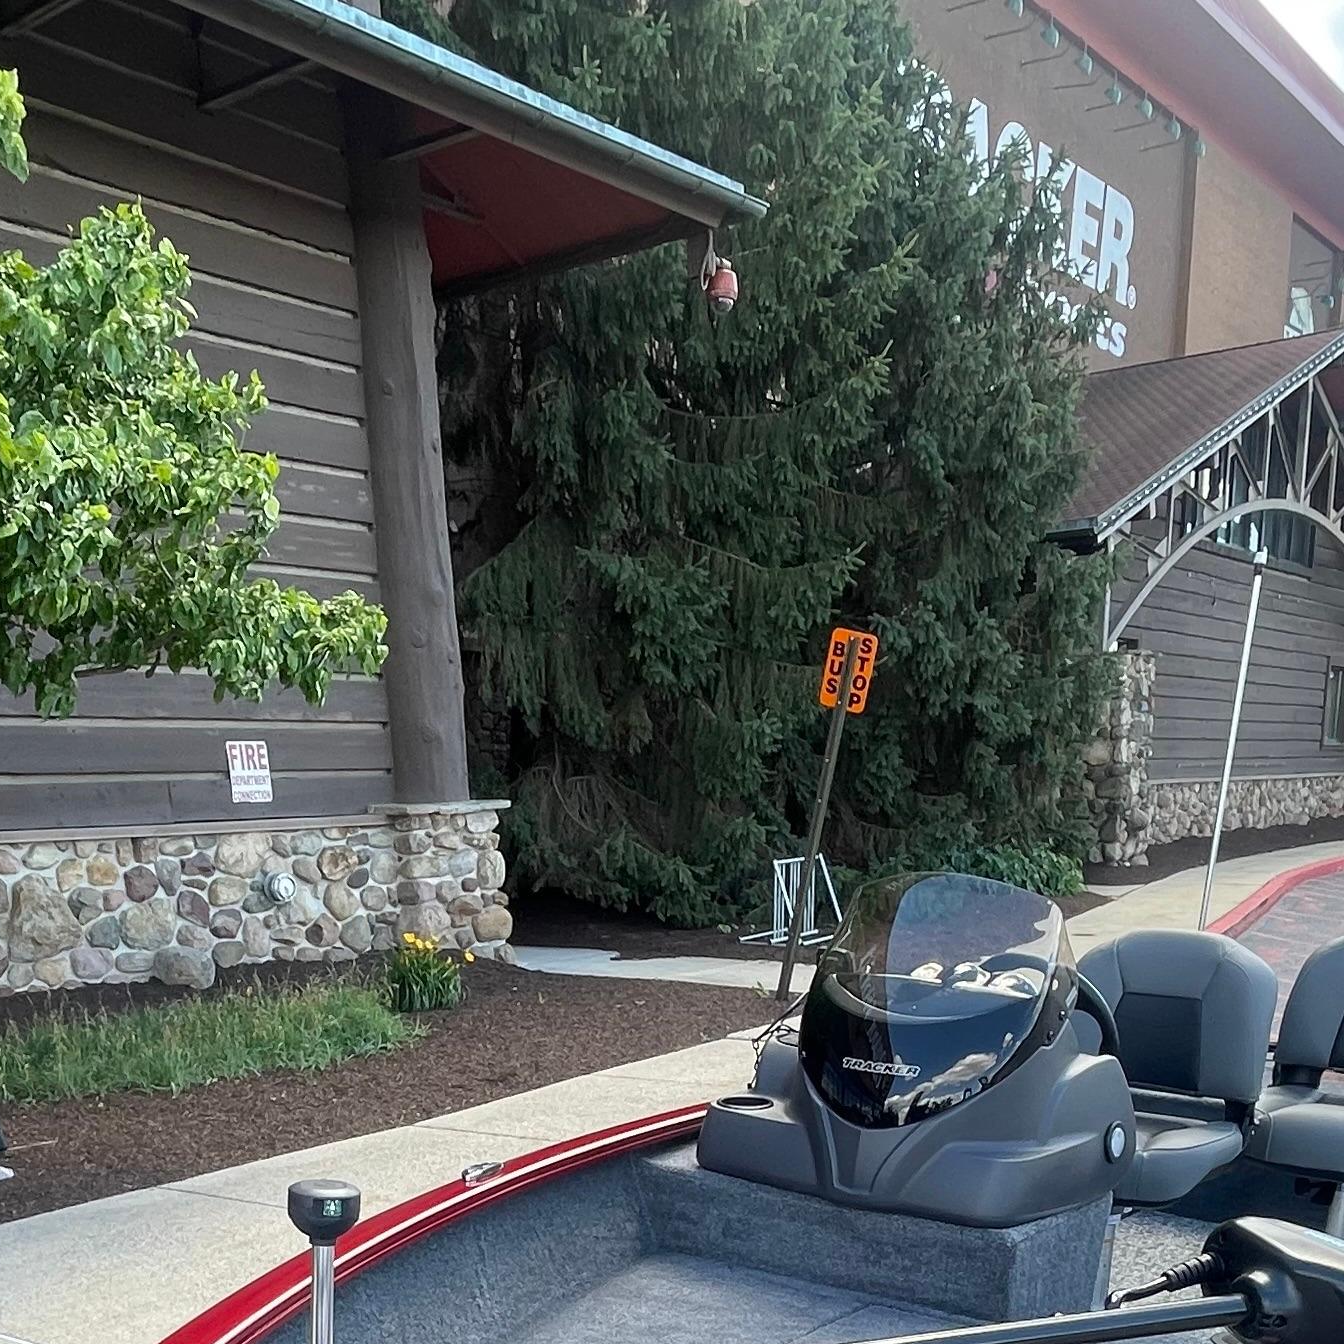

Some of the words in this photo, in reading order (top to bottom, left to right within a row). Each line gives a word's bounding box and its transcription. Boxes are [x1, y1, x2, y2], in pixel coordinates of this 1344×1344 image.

[825, 640, 846, 695] BUS
[847, 637, 873, 708] STOP
[228, 743, 268, 771] FIRE
[231, 774, 271, 786] DEPARTMENT
[842, 1057, 921, 1078] TRACKER
